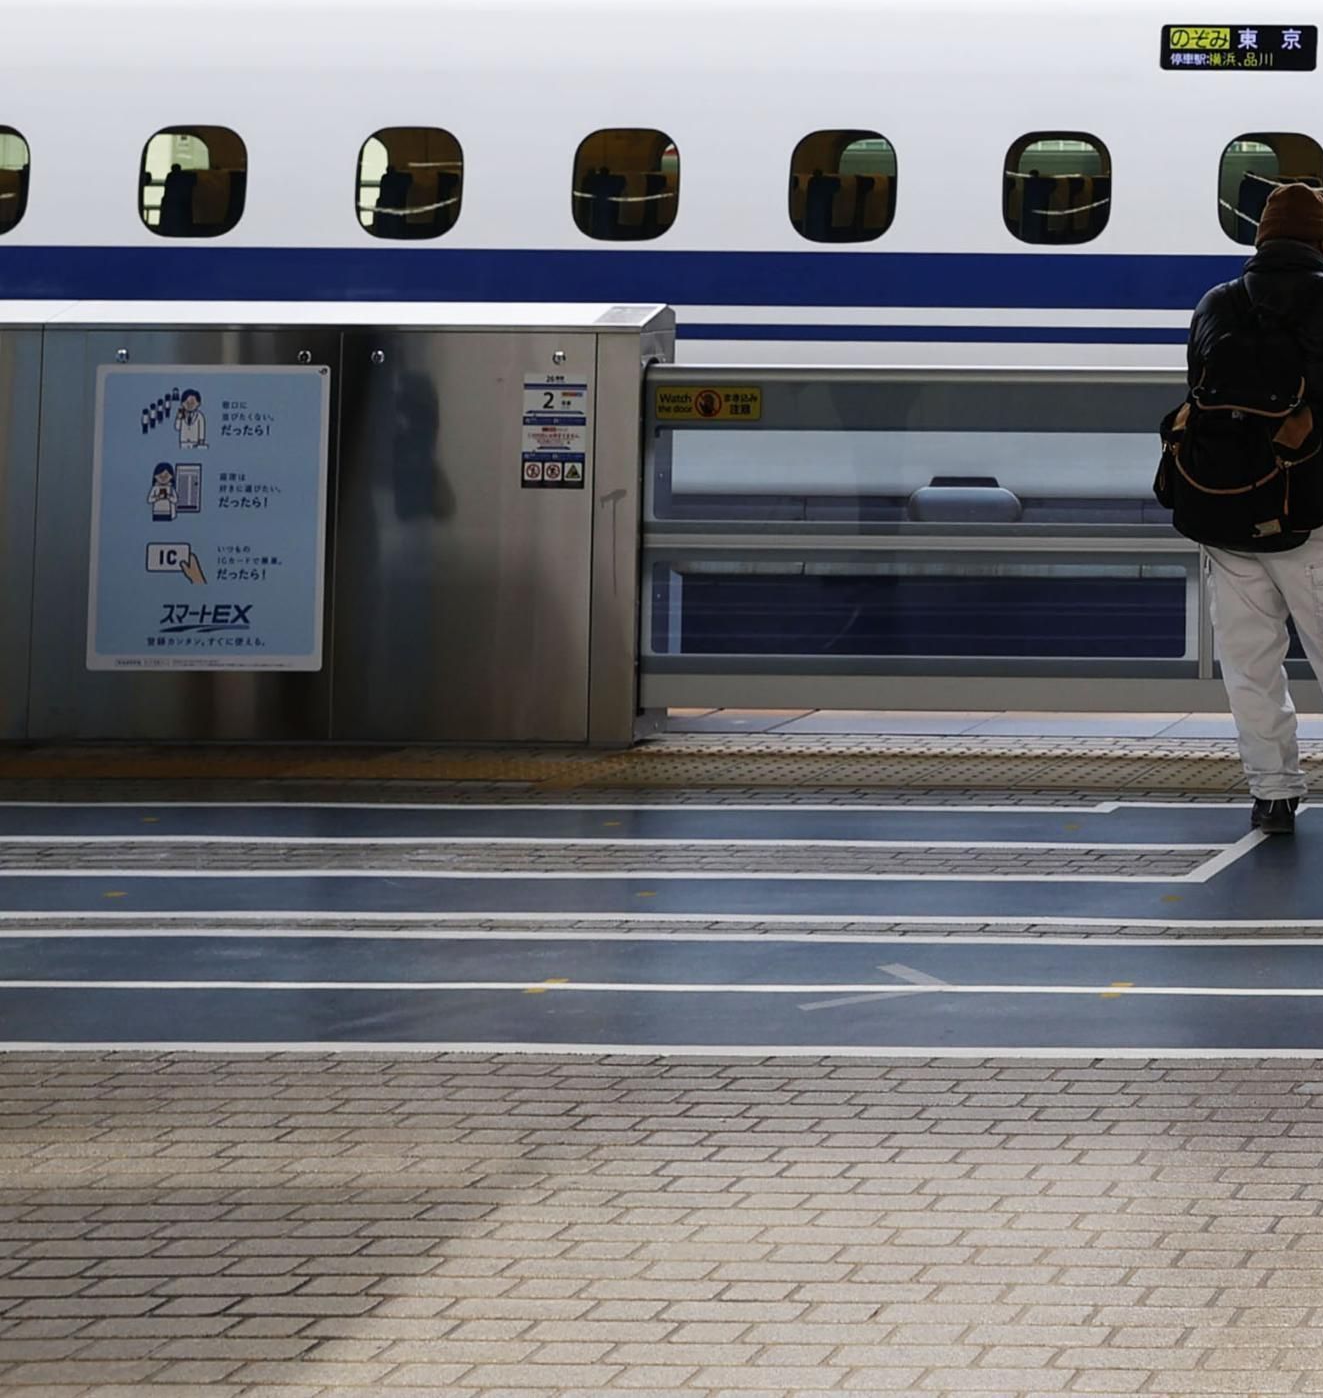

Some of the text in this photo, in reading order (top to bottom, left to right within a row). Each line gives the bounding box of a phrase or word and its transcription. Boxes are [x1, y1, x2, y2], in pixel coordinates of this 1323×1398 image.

[1170, 28, 1303, 50] のぞみ 東京
[543, 391, 554, 409] 2
[659, 394, 692, 403] Watch
[159, 549, 178, 565] IC
[160, 604, 253, 624] スマートEX
